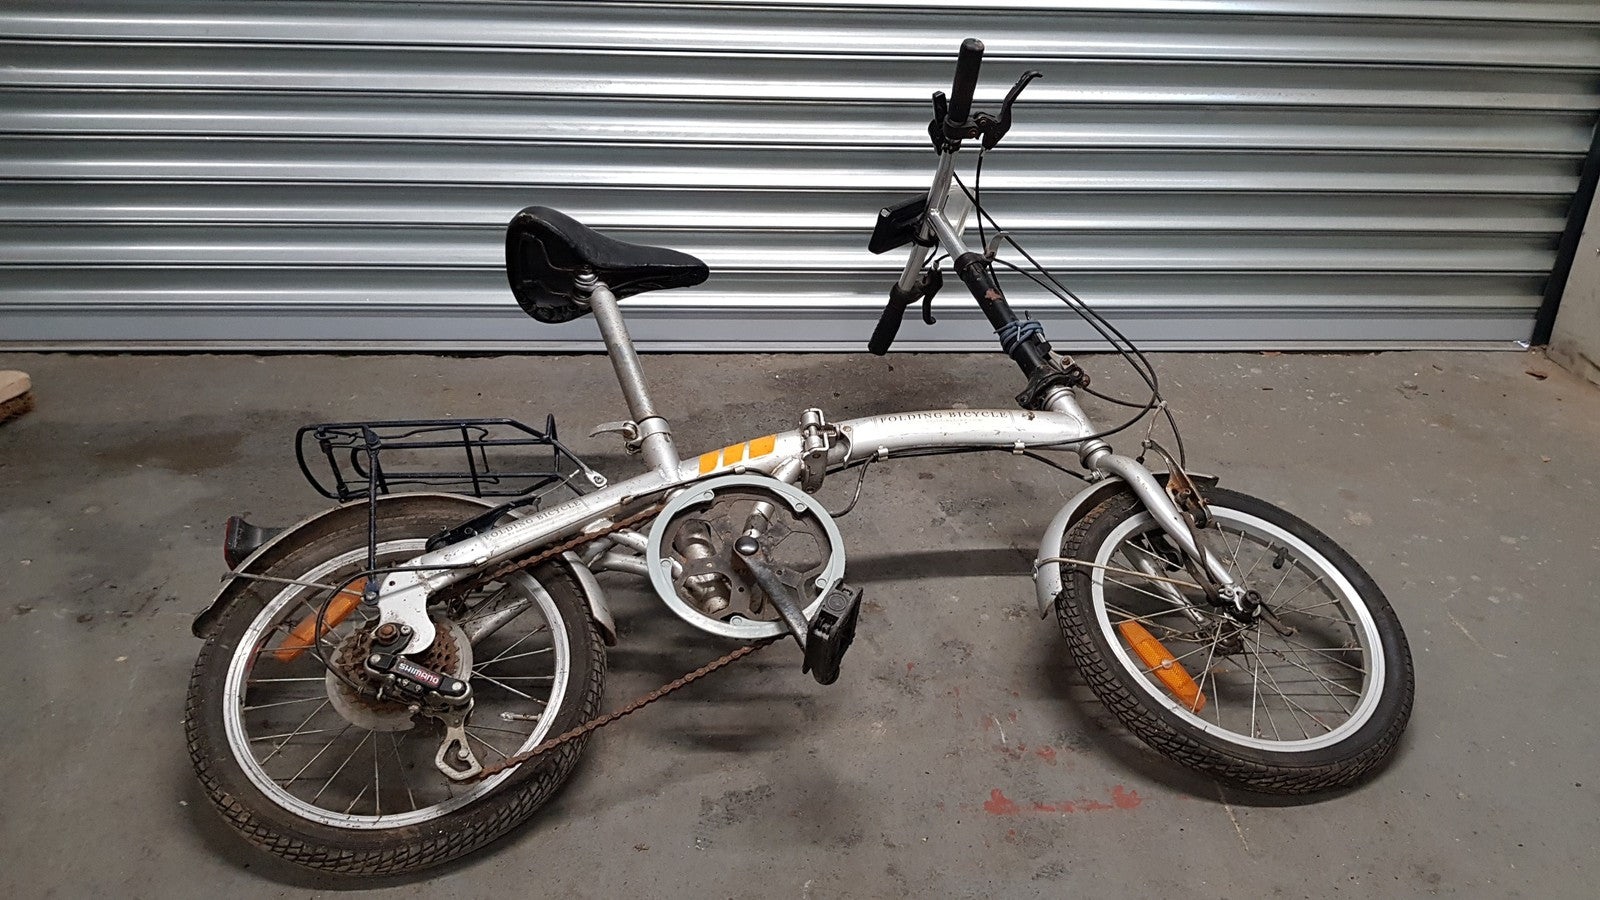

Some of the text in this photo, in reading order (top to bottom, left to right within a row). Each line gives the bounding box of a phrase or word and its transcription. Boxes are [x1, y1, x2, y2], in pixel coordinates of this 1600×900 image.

[880, 412, 943, 423] FOLDING
[948, 410, 1008, 419] BICYCLE
[398, 662, 439, 684] SHIMANO
